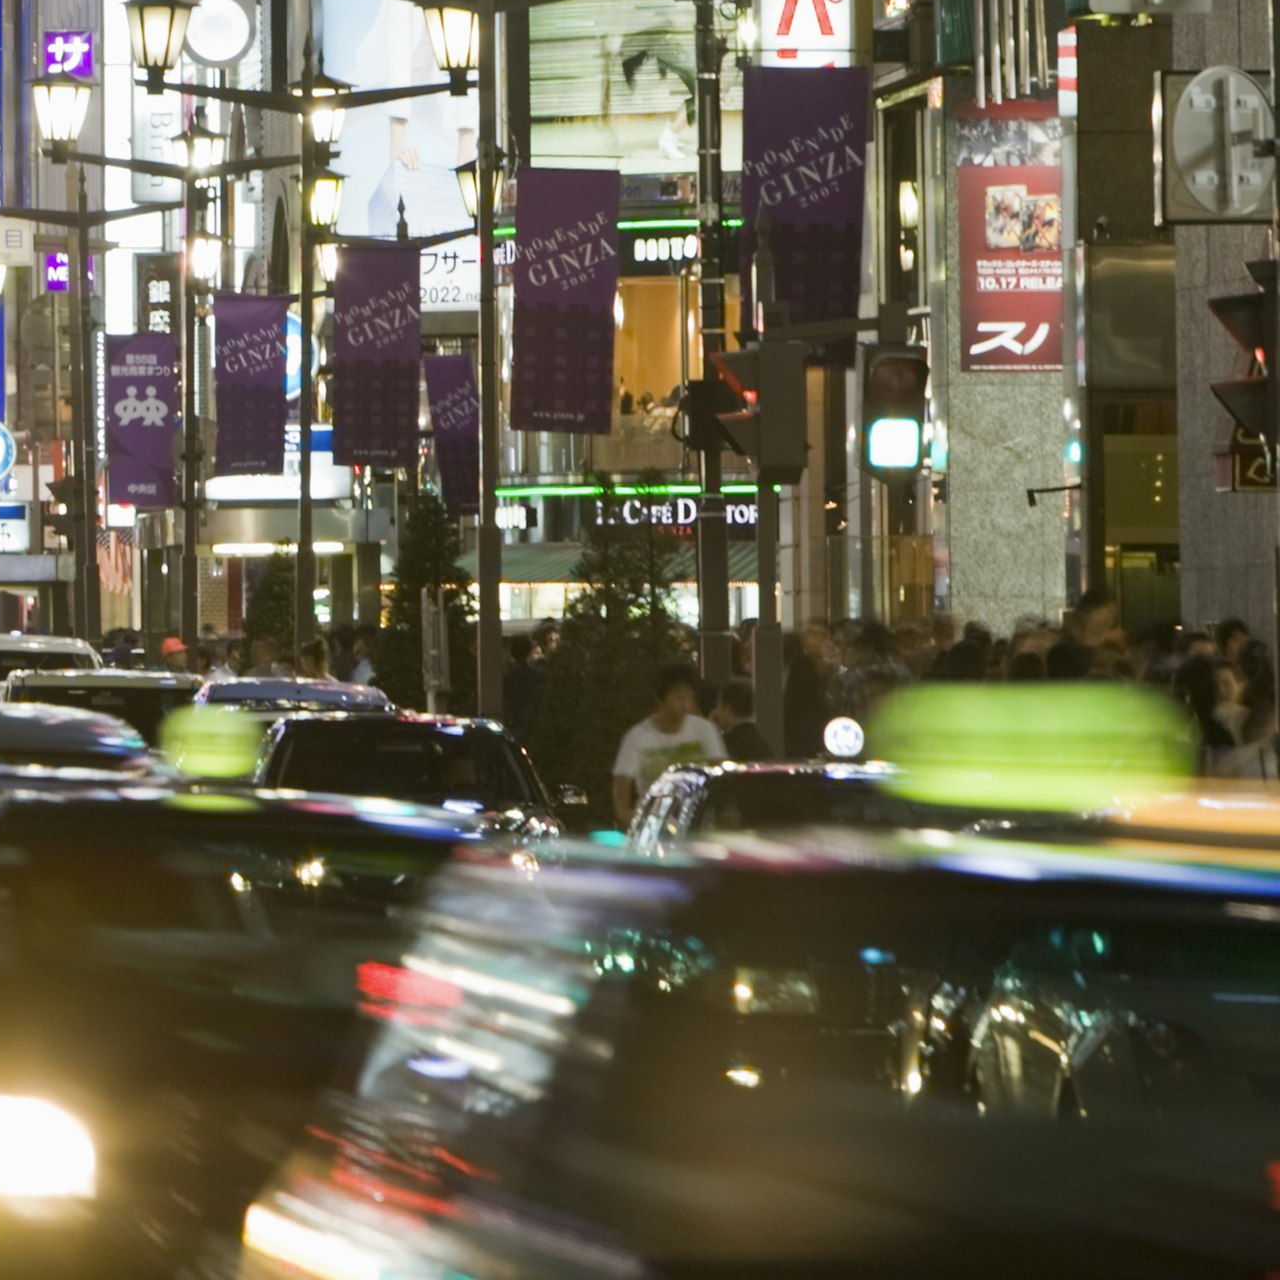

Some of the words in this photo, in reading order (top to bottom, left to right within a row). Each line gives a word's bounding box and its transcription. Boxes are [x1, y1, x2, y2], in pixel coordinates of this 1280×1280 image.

[742, 113, 854, 177] PROMENADE
[760, 144, 866, 207] GINZA
[798, 180, 843, 209] 2007
[515, 210, 609, 264] PROMENADE
[528, 235, 617, 287] GINZA
[561, 267, 598, 291] 2007
[978, 276, 1017, 290] 10.17
[334, 279, 414, 324] PROMENADE
[215, 322, 281, 358] PROMENADE
[346, 303, 420, 349] GINZA
[375, 330, 406, 350] 2007
[224, 341, 287, 375] GINZA
[248, 360, 274, 377] 2007
